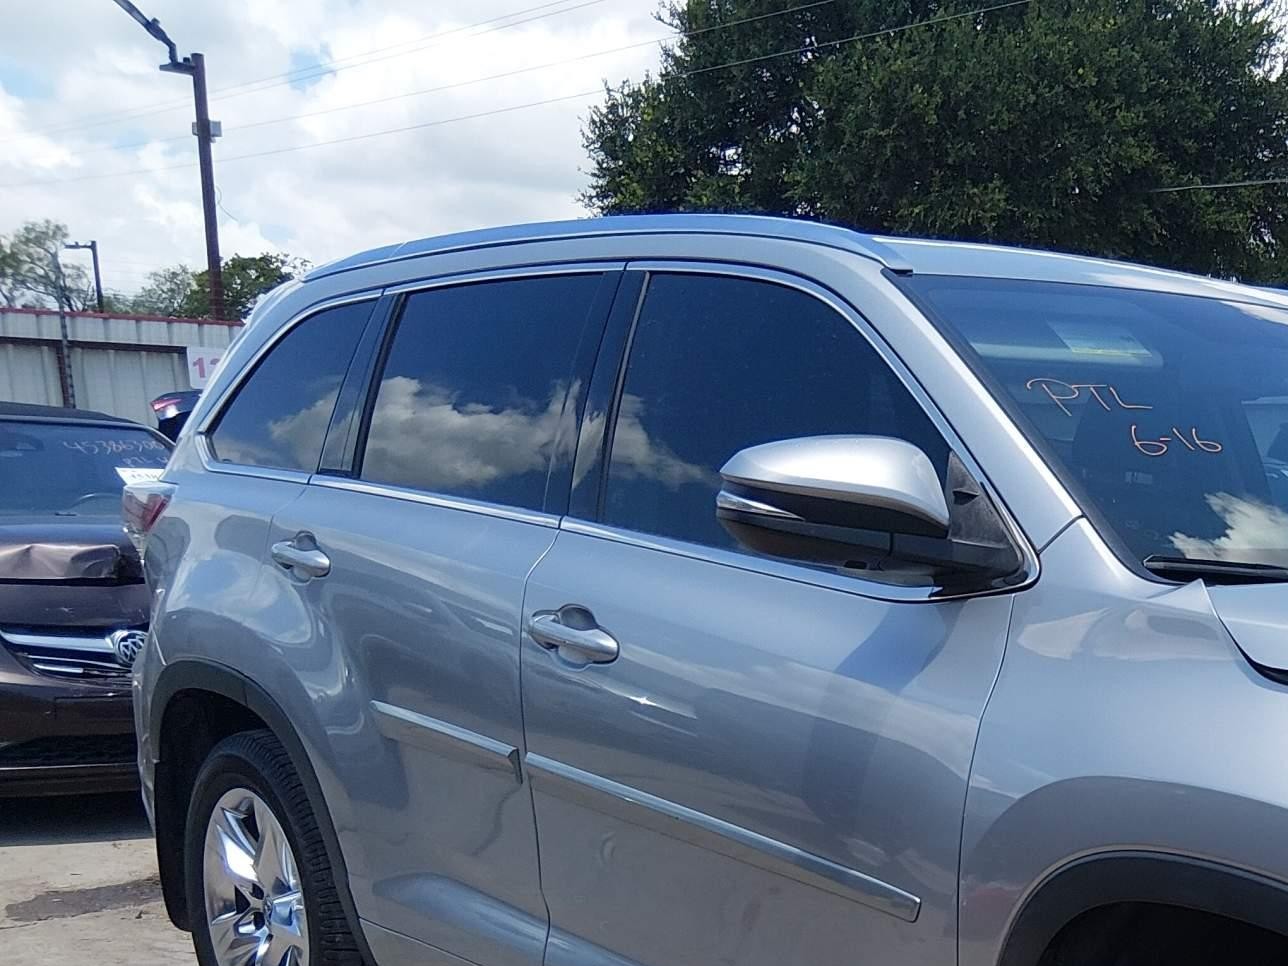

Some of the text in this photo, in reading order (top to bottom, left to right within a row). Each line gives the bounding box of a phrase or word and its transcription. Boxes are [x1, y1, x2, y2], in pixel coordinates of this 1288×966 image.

[192, 357, 220, 378] 1
[1026, 377, 1153, 417] PTL
[1130, 424, 1223, 456] 6-16
